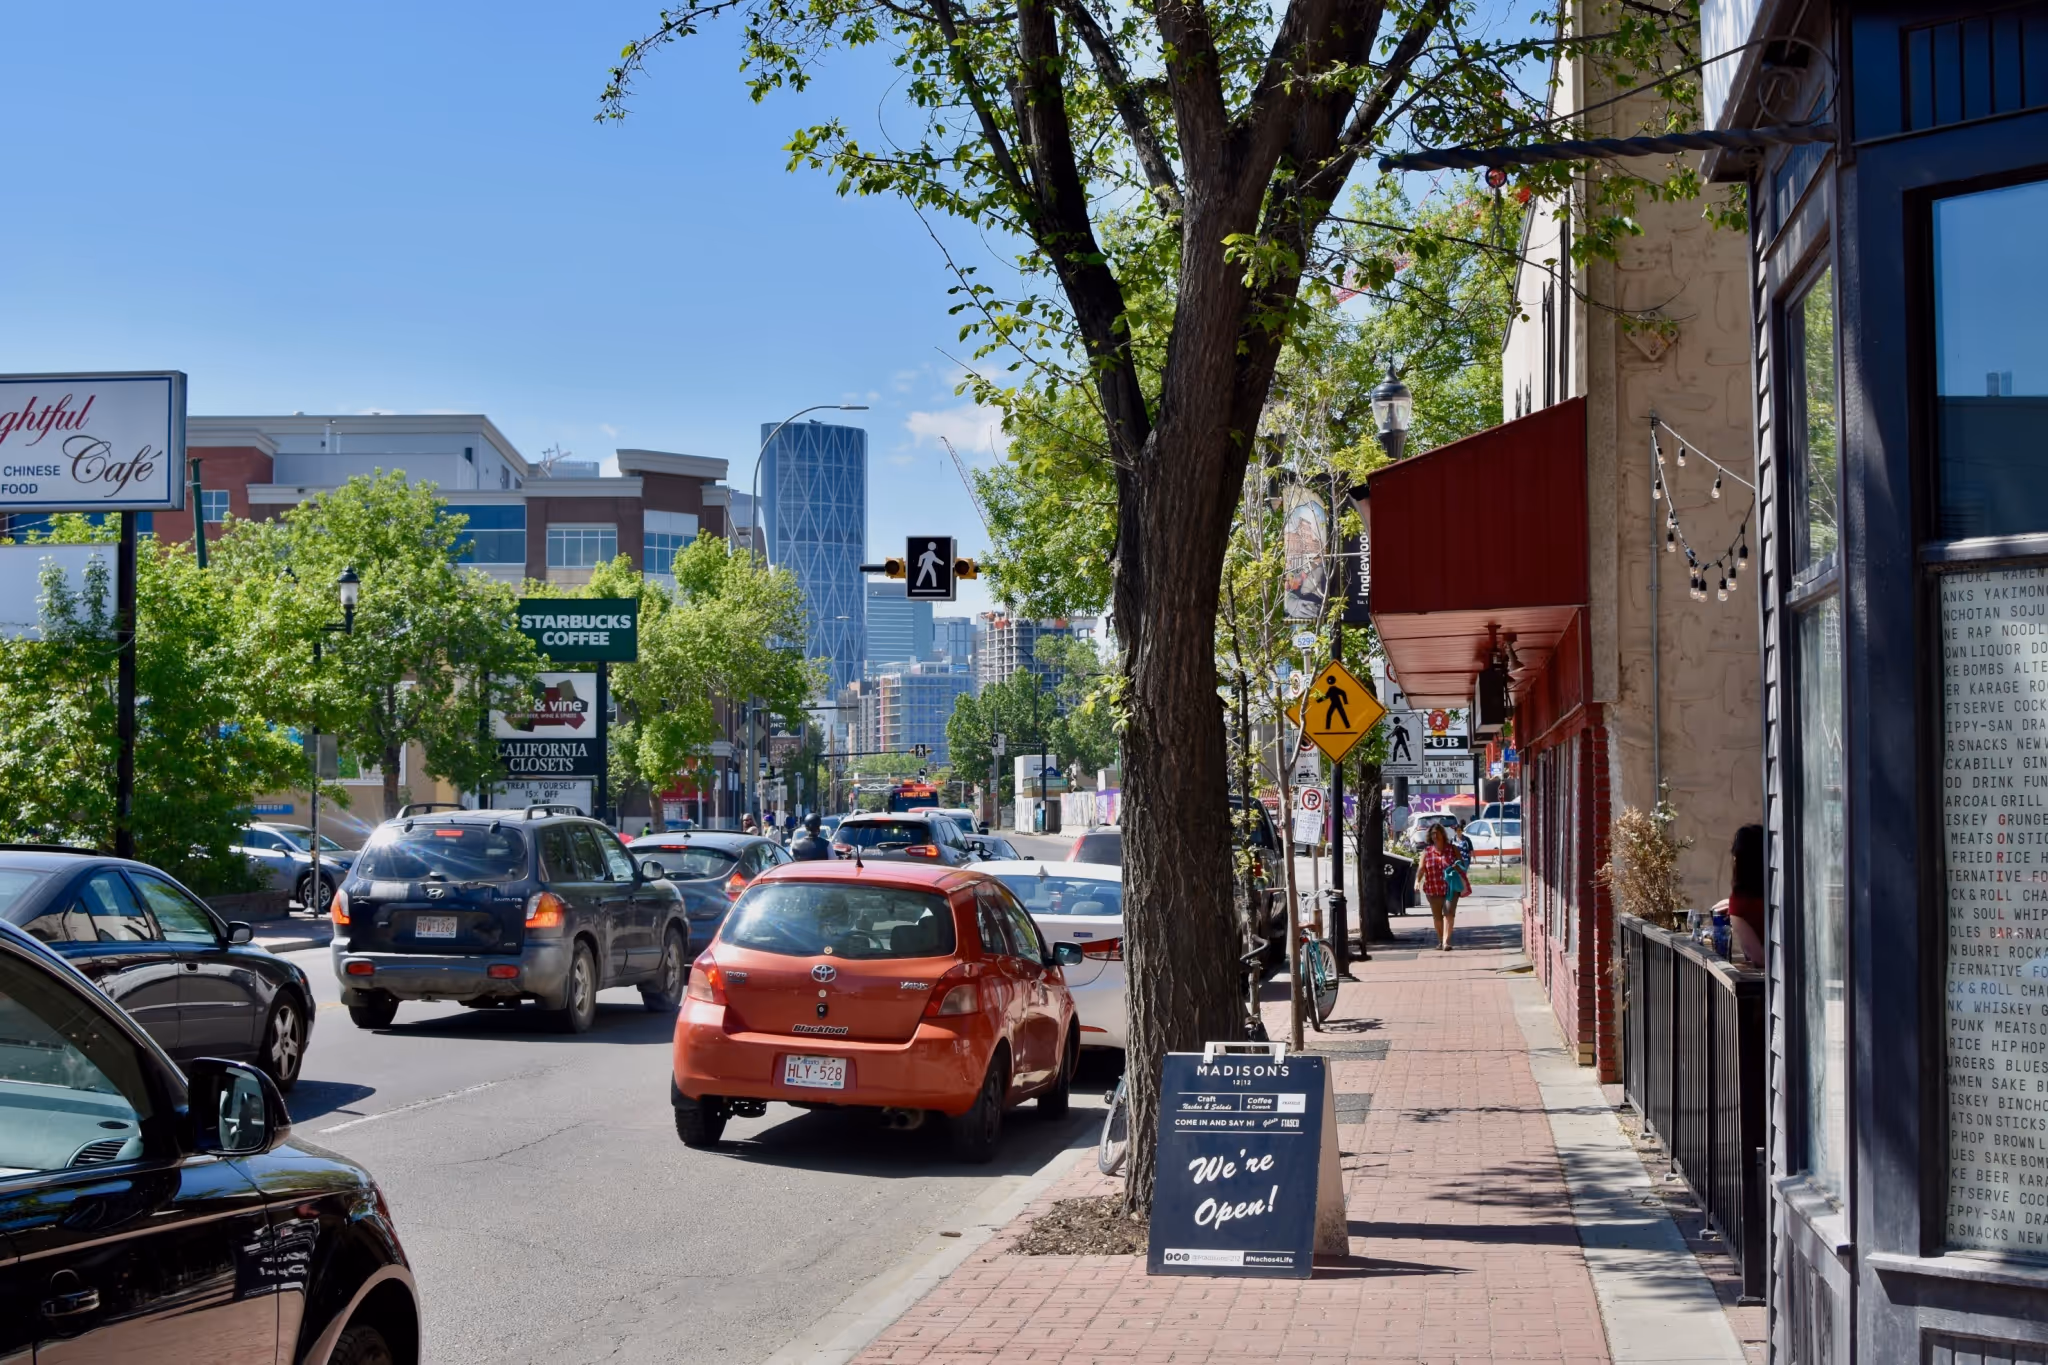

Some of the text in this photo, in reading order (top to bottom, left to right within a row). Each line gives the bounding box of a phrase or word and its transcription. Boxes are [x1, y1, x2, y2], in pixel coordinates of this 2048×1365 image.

[4, 465, 60, 476] CHINESE
[62, 435, 163, 498] Café
[1, 484, 38, 494] FOOD
[1943, 590, 1974, 603] ANKS
[1943, 604, 2045, 621] NCHOTAN SOJU
[521, 615, 631, 629] STARBUCKS
[542, 632, 610, 645] COFFEE
[1945, 628, 1958, 640] NE
[1968, 626, 1991, 638] RAP
[1971, 643, 2020, 657] LIQUOR
[1964, 663, 2004, 676] BOMBS
[1947, 680, 2048, 696] ER KARAGE RO
[534, 699, 546, 712] &
[549, 697, 582, 712] vine
[1964, 701, 2004, 714] SERVE
[2014, 699, 2046, 712] COCK
[1946, 718, 2046, 733] IPPY-SAN DRA
[496, 743, 588, 757] CALIFORNIA
[1959, 739, 2007, 751] SNACKS
[510, 758, 574, 771] CLOSETS
[1946, 756, 2047, 770] CKABILLY GIN
[1946, 776, 2047, 788] OD DRINK FUN
[545, 790, 559, 798] OFF
[1945, 794, 2042, 807] ARCOAL GRILL
[1946, 814, 1987, 826] ISKEY
[1951, 832, 2013, 844] MEATS ON
[1953, 851, 1992, 863] FRIED
[1997, 852, 2030, 863] RICE
[1952, 889, 1965, 900] CK
[1950, 907, 1963, 919] NK
[1974, 908, 2004, 920] SOUL
[1951, 926, 1980, 938] DLES
[1962, 945, 1999, 957] BURRI
[1951, 963, 2021, 977] TERNATIVE
[1981, 982, 2013, 995] ROLL
[2021, 984, 2048, 997] CHA
[1948, 1000, 1963, 1012] NK
[1974, 1001, 2031, 1015] WHISKEY
[792, 1024, 849, 1035] Blackfoot
[1952, 1019, 1984, 1032] PUNK
[1995, 1021, 2036, 1034] MEATS
[1950, 1038, 2045, 1054] RICE HIP HOP
[1197, 1065, 1290, 1077] MADISON'S
[2006, 1060, 2048, 1073] BLUES
[1992, 1078, 2026, 1090] SAKE
[1197, 1095, 1216, 1103] Craft
[1247, 1097, 1273, 1105] Coffee
[1951, 1093, 1988, 1107] ISKEY
[1951, 1112, 2045, 1130] ATS ON STICKS
[1962, 1131, 1984, 1143] HOP
[1994, 1134, 2034, 1148] BROWN
[1952, 1149, 2048, 1168] UES SAKE BOM
[1188, 1149, 1275, 1184] We're
[1952, 1167, 1966, 1179] KE
[1977, 1170, 2008, 1184] BEER
[1968, 1188, 2009, 1202] SERVE
[2020, 1193, 2048, 1206] COC
[1194, 1185, 1279, 1230] Open!
[1949, 1204, 2015, 1222] IPPY-SAN
[1959, 1225, 2008, 1240] SNACKS
[2018, 1231, 2043, 1244] NEW
[1245, 1255, 1294, 1264] #Nachos4Life
